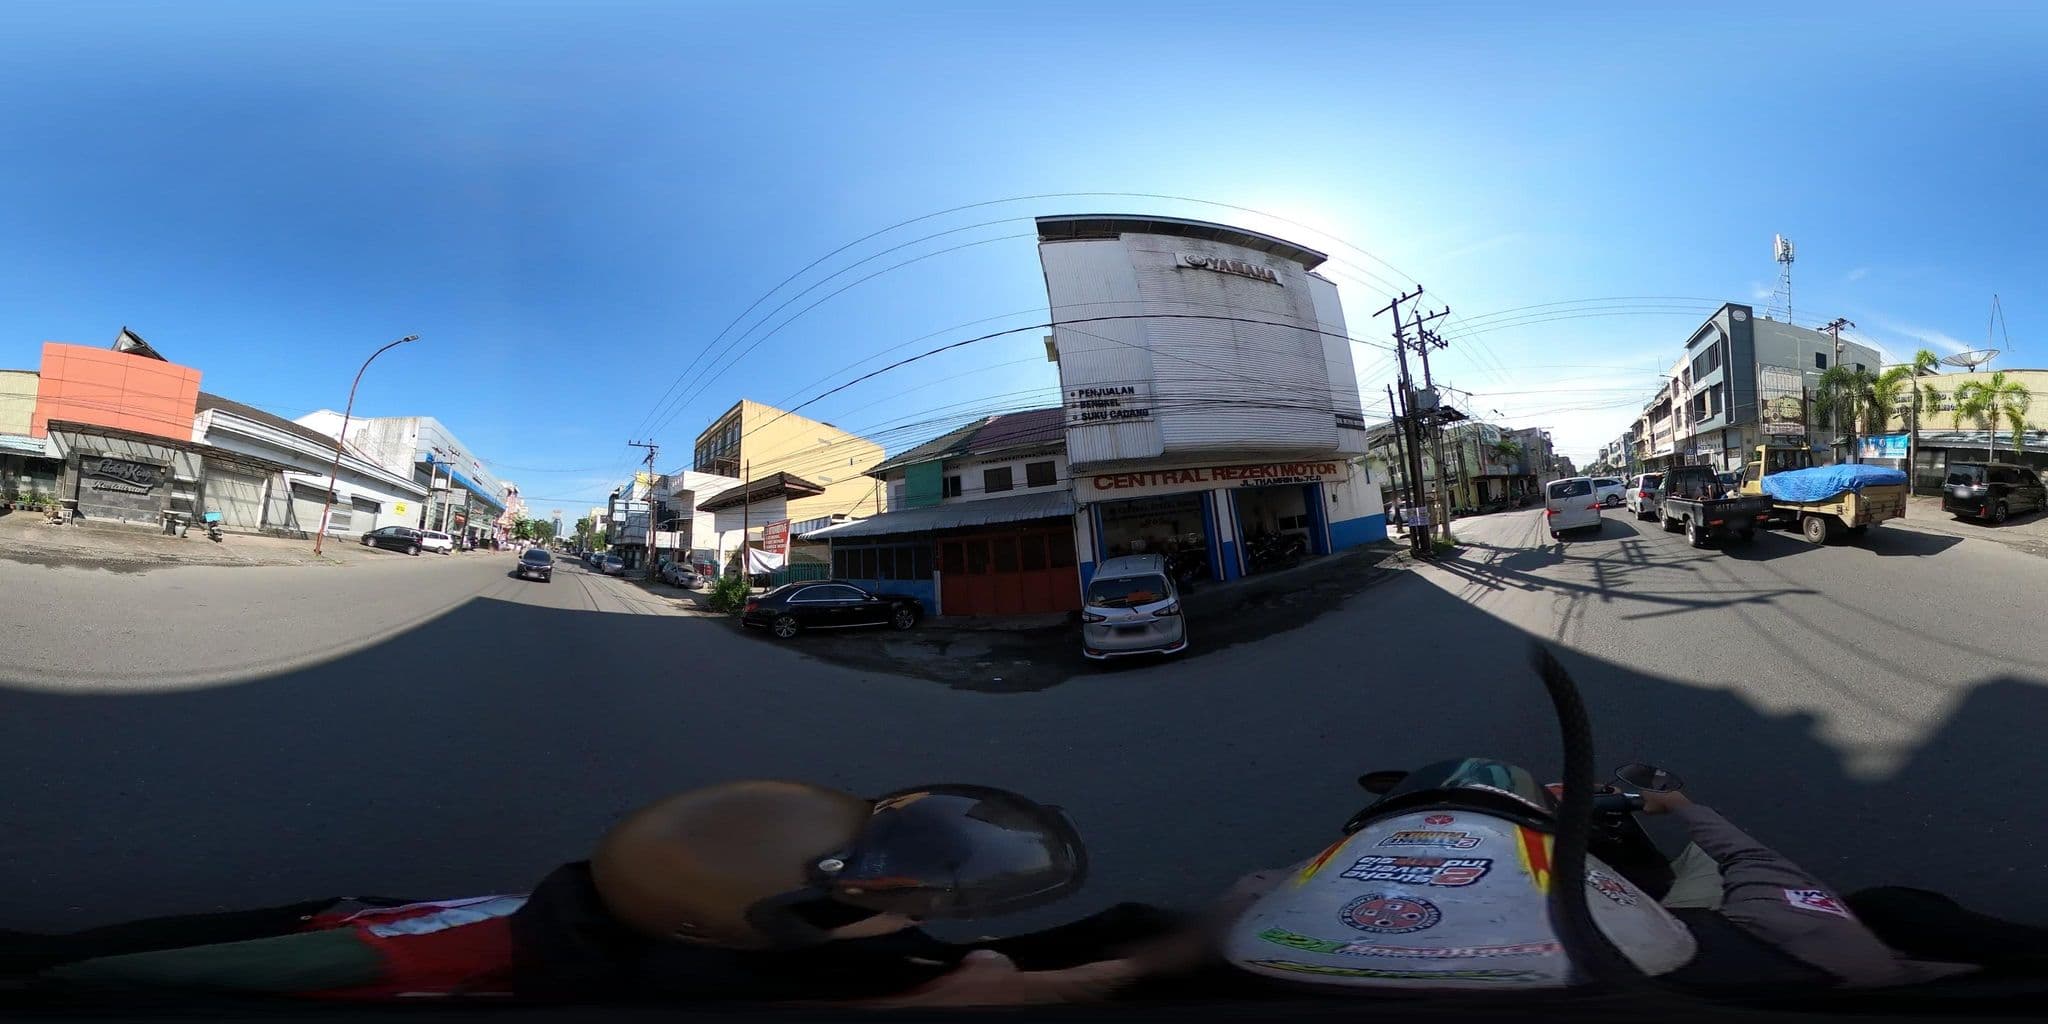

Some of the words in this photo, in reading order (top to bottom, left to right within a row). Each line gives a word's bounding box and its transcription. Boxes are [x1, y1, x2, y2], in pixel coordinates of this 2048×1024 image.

[1206, 258, 1277, 282] YAMAHA
[1079, 386, 1134, 398] PENJUALAN
[1081, 411, 1107, 420] SUKU
[1109, 409, 1149, 419] CADANG
[1093, 467, 1208, 490] CENTRAL
[1212, 464, 1277, 480] REZEKI
[1279, 463, 1337, 477] MOTOR
